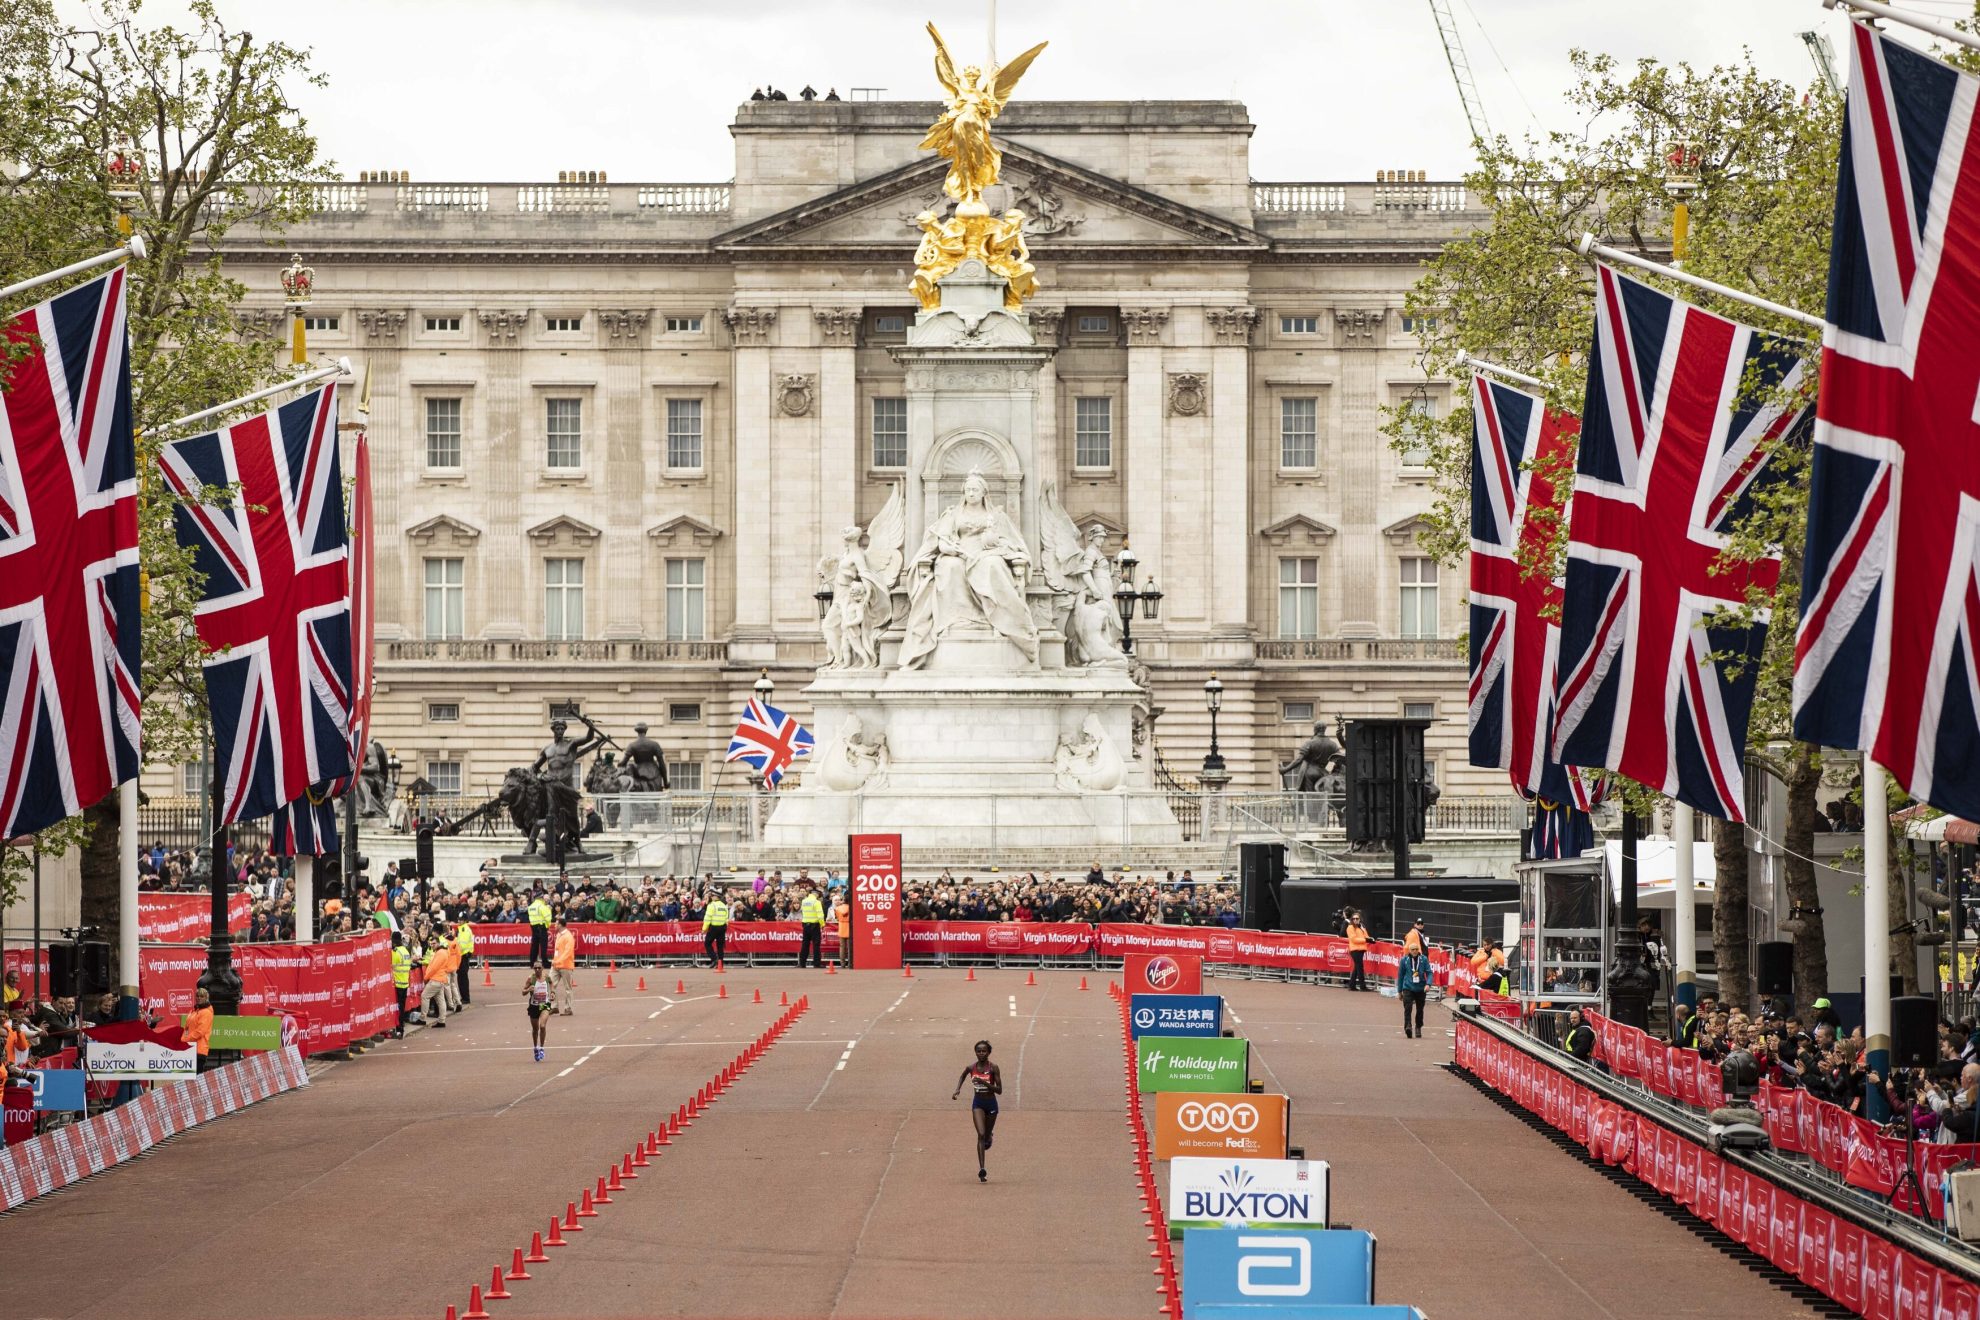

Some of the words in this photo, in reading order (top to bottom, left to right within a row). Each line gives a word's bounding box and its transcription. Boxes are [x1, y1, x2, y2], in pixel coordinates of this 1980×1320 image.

[856, 874, 898, 892] 200
[858, 893, 895, 902] METRES
[862, 902, 874, 910] TO
[877, 902, 892, 910] GO
[582, 933, 607, 946] Virgin
[609, 934, 636, 946] Money
[638, 933, 673, 944] London
[735, 931, 766, 942] London
[768, 931, 803, 942] Maratho
[909, 931, 940, 942] London
[942, 931, 980, 942] Marathon
[1024, 932, 1046, 944] Virgin
[1049, 932, 1078, 944] Money
[1101, 934, 1124, 946] Virgin
[1126, 935, 1150, 948] Money
[1152, 936, 1176, 947] London
[1176, 938, 1206, 949] Marathon
[1237, 942, 1254, 955] Virgin
[1256, 943, 1276, 956] Money
[1276, 944, 1297, 956] London
[1298, 946, 1324, 958] Marathon
[148, 958, 168, 974] virgin
[170, 960, 192, 972] money
[192, 958, 208, 970] lond
[254, 956, 264, 970] virgin
[264, 958, 276, 970] money
[276, 956, 288, 967] london
[288, 956, 310, 968] marathon
[1148, 960, 1176, 986] Virgin
[280, 992, 289, 1006] virgin
[290, 994, 302, 1006] money
[314, 990, 330, 1001] marathon
[1158, 1008, 1214, 1020] 万达体育
[92, 1060, 134, 1070] BUXTON
[148, 1060, 192, 1069] BUXTON
[1168, 1056, 1216, 1072] Holiday
[1218, 1056, 1238, 1070] Inn
[1192, 1140, 1223, 1148] become
[1226, 1137, 1257, 1148] FedEx
[1185, 1192, 1308, 1219] BUXTON
